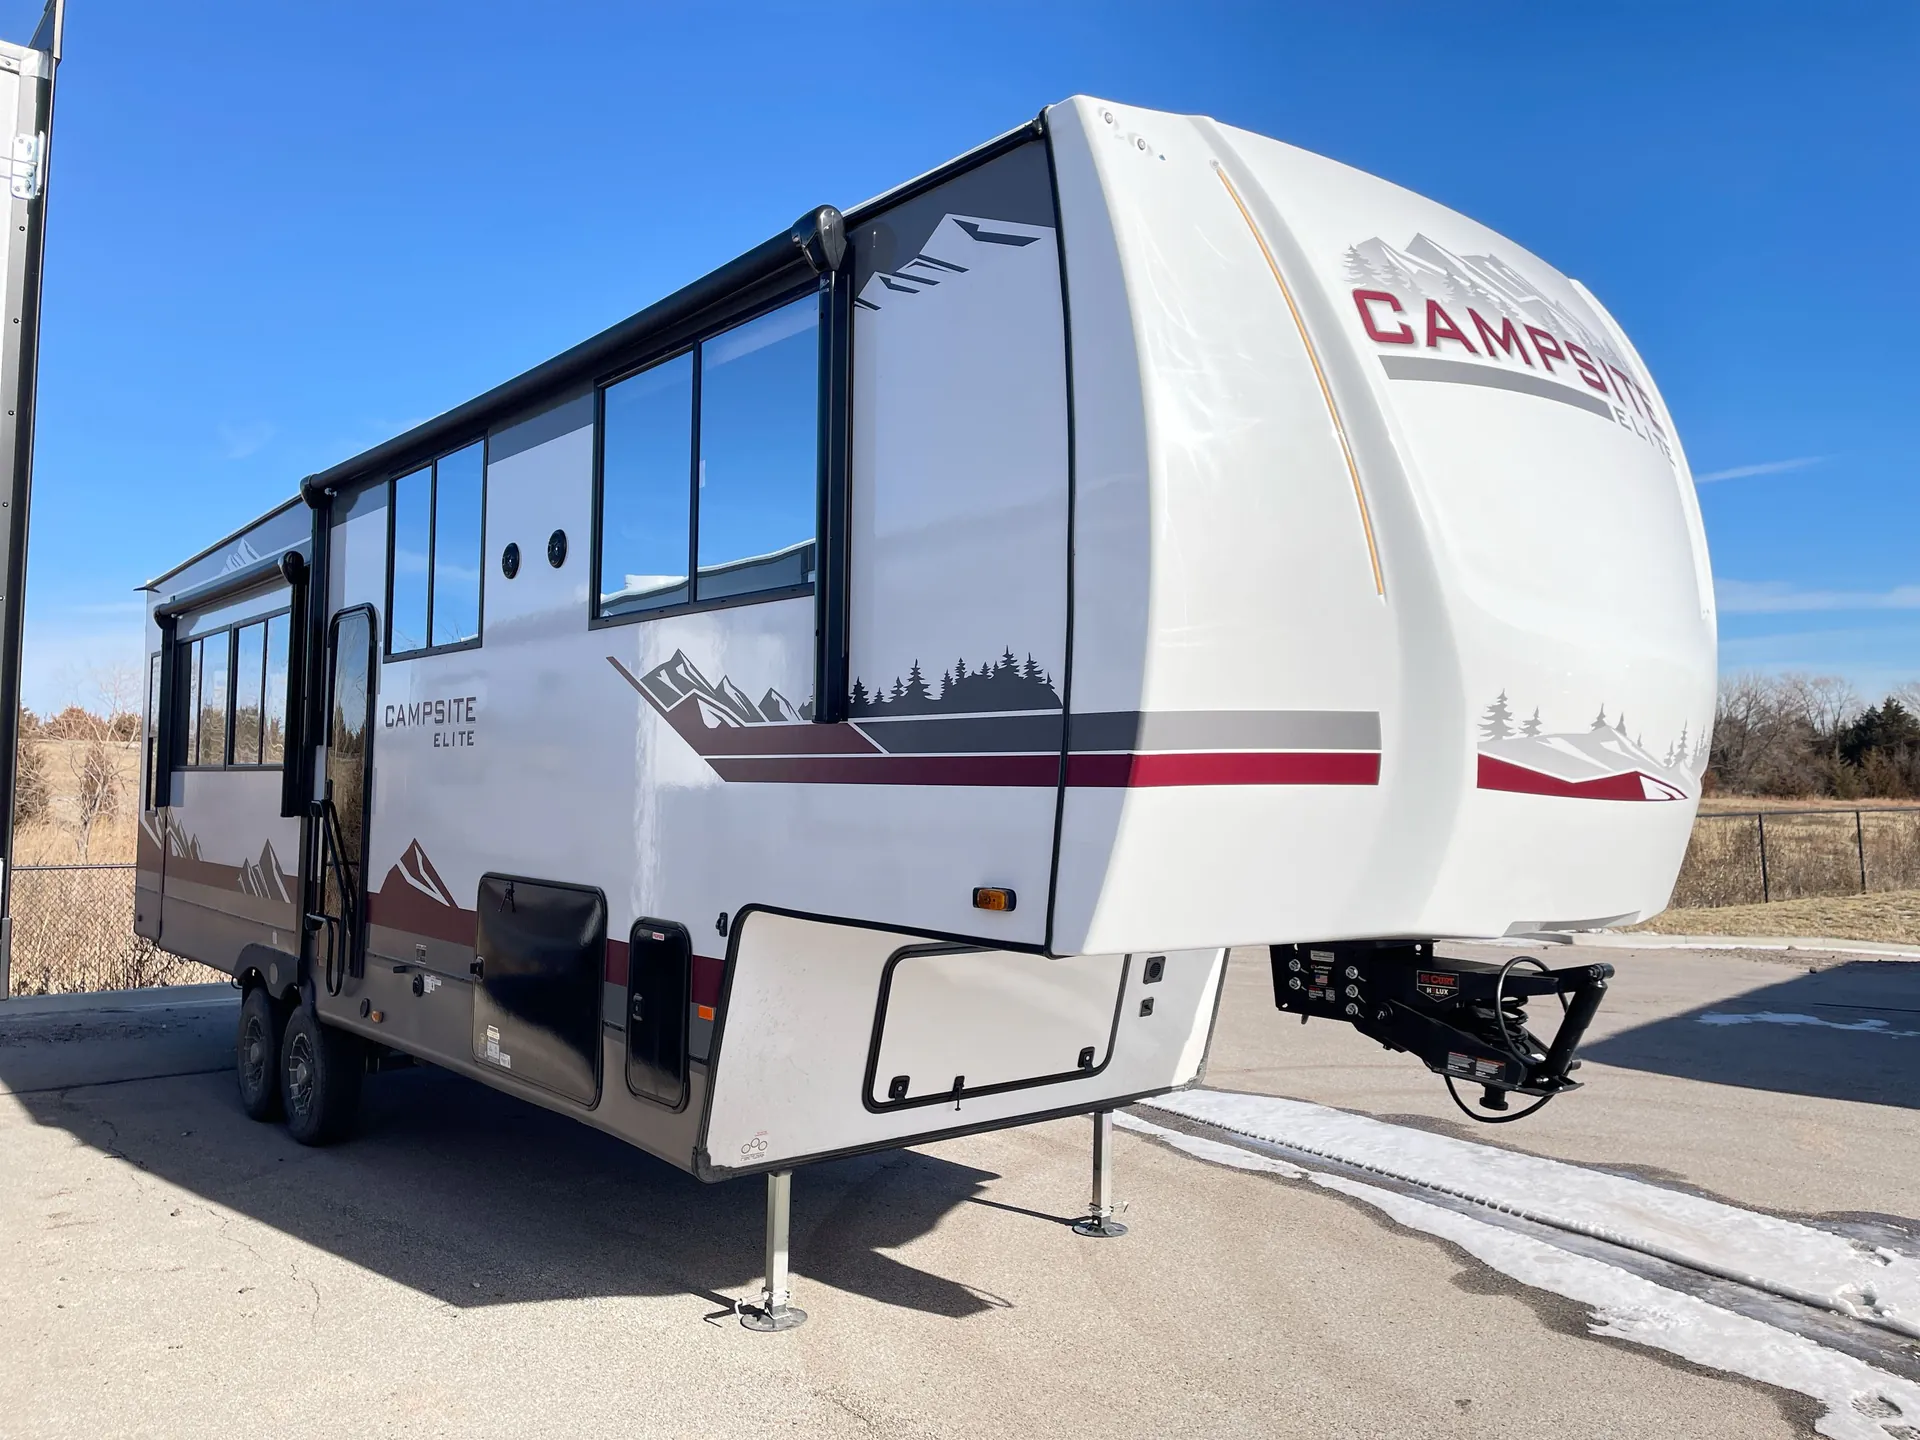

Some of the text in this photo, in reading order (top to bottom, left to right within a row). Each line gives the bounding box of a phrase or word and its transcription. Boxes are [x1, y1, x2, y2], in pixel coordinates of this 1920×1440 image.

[1352, 288, 1667, 440] CAMPSITE
[1613, 406, 1676, 467] ELITE
[385, 696, 477, 728] CAMPSITE
[433, 731, 475, 747] ELITE
